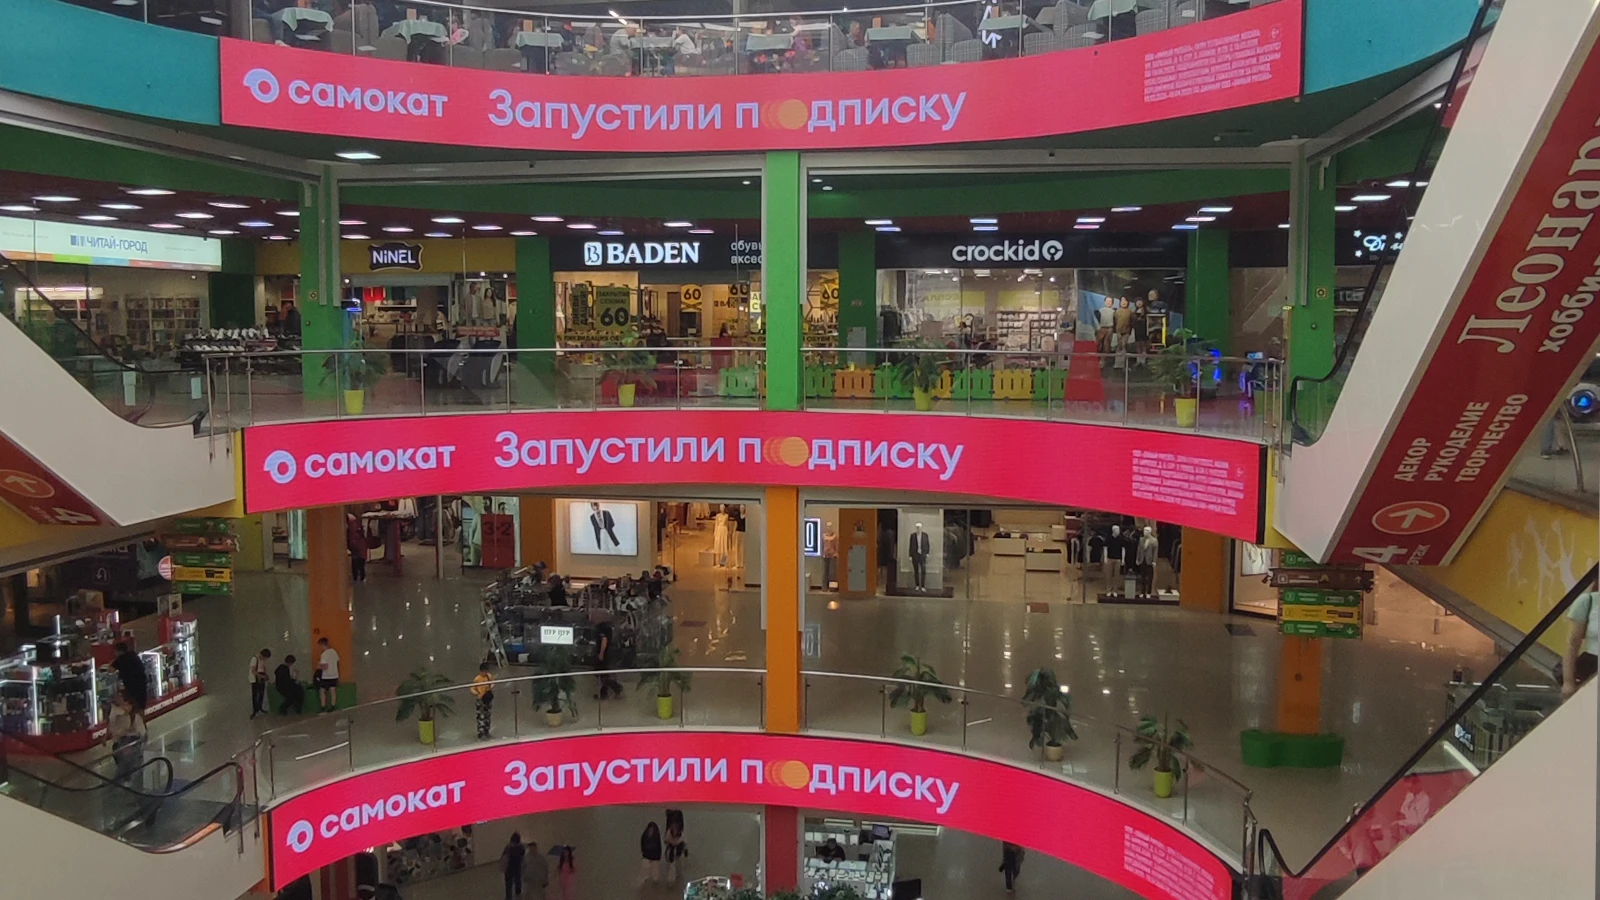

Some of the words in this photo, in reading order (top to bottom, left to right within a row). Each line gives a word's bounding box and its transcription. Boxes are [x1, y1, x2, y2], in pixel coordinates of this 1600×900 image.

[288, 79, 450, 118] самокат
[488, 89, 723, 140] Запустили
[86, 236, 148, 254] ЧИТАЙ-ГОРОД
[607, 243, 701, 265] BADEN
[953, 240, 1034, 262] crockid
[684, 288, 701, 300] 60
[600, 307, 629, 327] 60
[495, 431, 726, 475] Запустили
[1424, 401, 1490, 482] РУКОДЕЛИЕ
[1454, 394, 1529, 483] ТВОРЧЕСТВО
[305, 446, 457, 479] самокат
[1394, 437, 1432, 482] ДЕКОР
[1351, 545, 1409, 563] 4
[504, 758, 728, 797] Запустили
[319, 778, 467, 840] самокат
